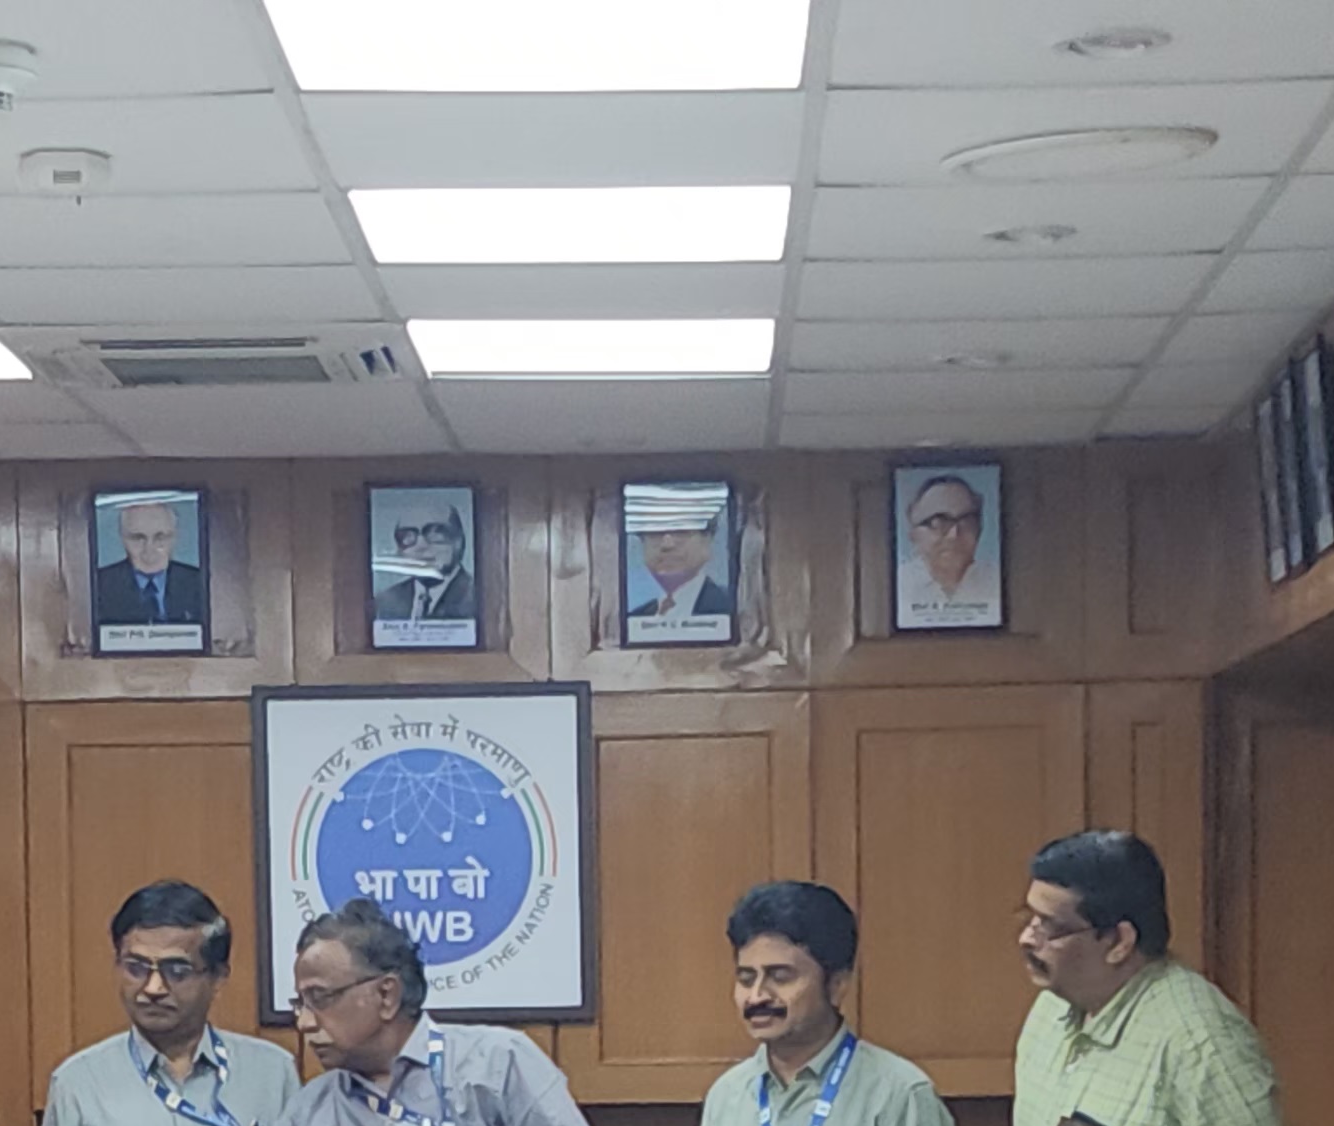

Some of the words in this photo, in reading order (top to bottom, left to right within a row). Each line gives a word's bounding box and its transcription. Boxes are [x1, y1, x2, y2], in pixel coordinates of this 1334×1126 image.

[354, 868, 398, 902] भा
[402, 868, 443, 900] पा
[447, 855, 490, 899] बो
[393, 910, 474, 943] WB
[461, 964, 483, 984] OF
[485, 942, 520, 971] THE
[515, 883, 554, 945] NATION
